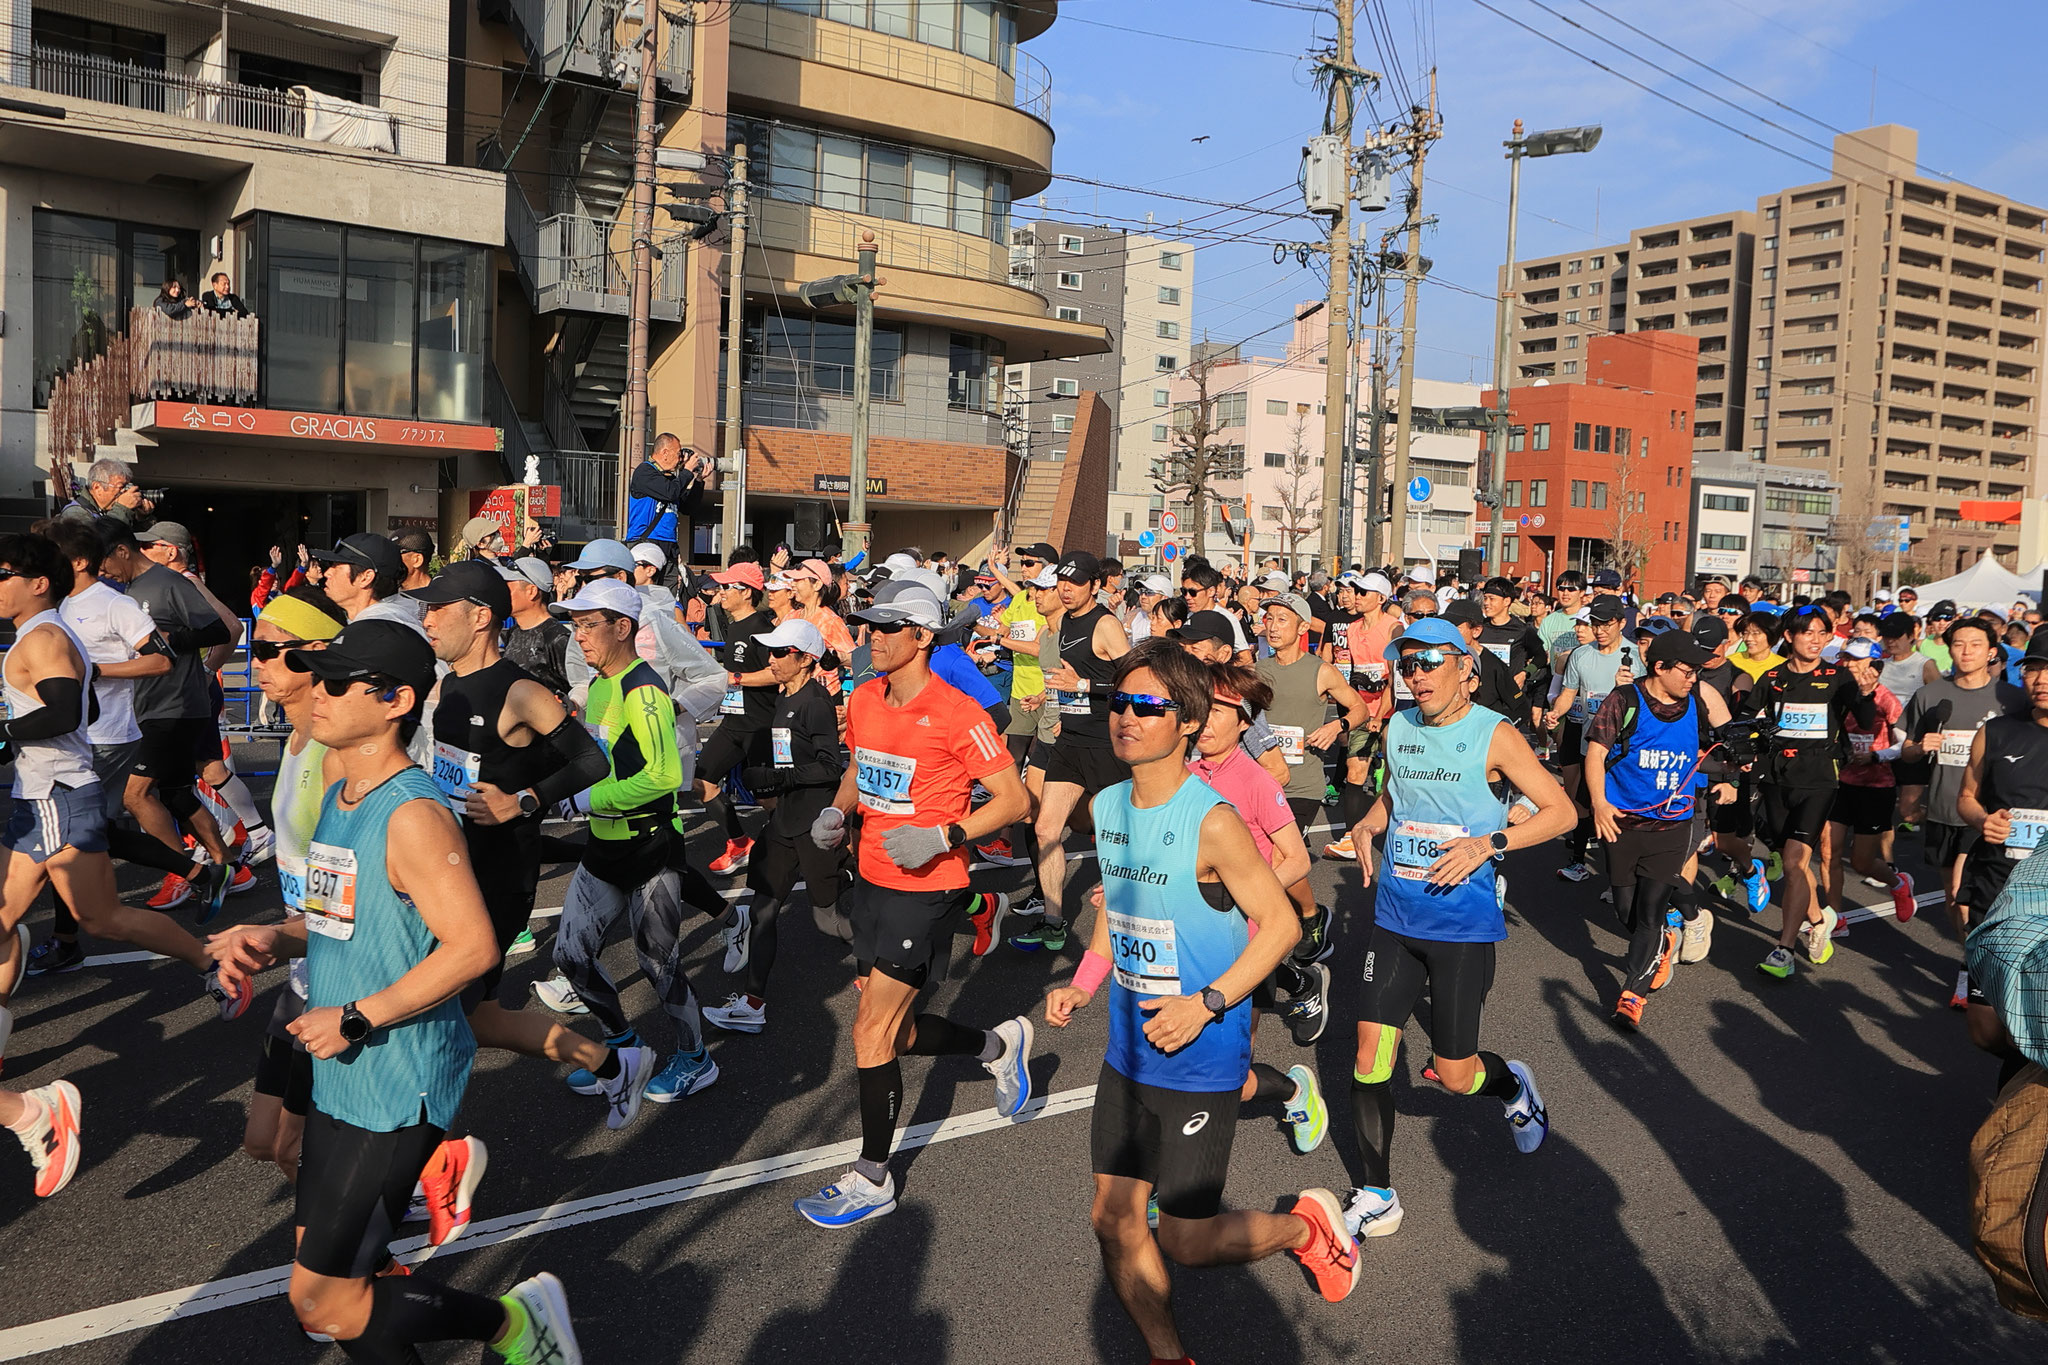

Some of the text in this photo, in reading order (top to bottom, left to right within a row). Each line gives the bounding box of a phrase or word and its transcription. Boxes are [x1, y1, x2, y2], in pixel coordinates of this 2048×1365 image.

[290, 415, 376, 441] GRACIAS
[400, 427, 446, 443] グラシアス
[819, 480, 849, 490] 高さ制限
[390, 519, 438, 529] GRACIAS
[1164, 517, 1175, 527] 40
[1332, 623, 1350, 633] RUN
[1784, 713, 1816, 725] 9557
[1397, 744, 1425, 755] 有村歯科
[438, 760, 464, 787] 2240
[866, 766, 903, 790] 2157
[1397, 765, 1462, 782] ChamaRen
[1656, 770, 1680, 790] 伴走
[1100, 829, 1129, 847] 有村歯科
[1394, 840, 1403, 853] B
[1099, 857, 1169, 886] ChamaRen
[1111, 933, 1157, 963] 1540
[1163, 966, 1175, 975] C2
